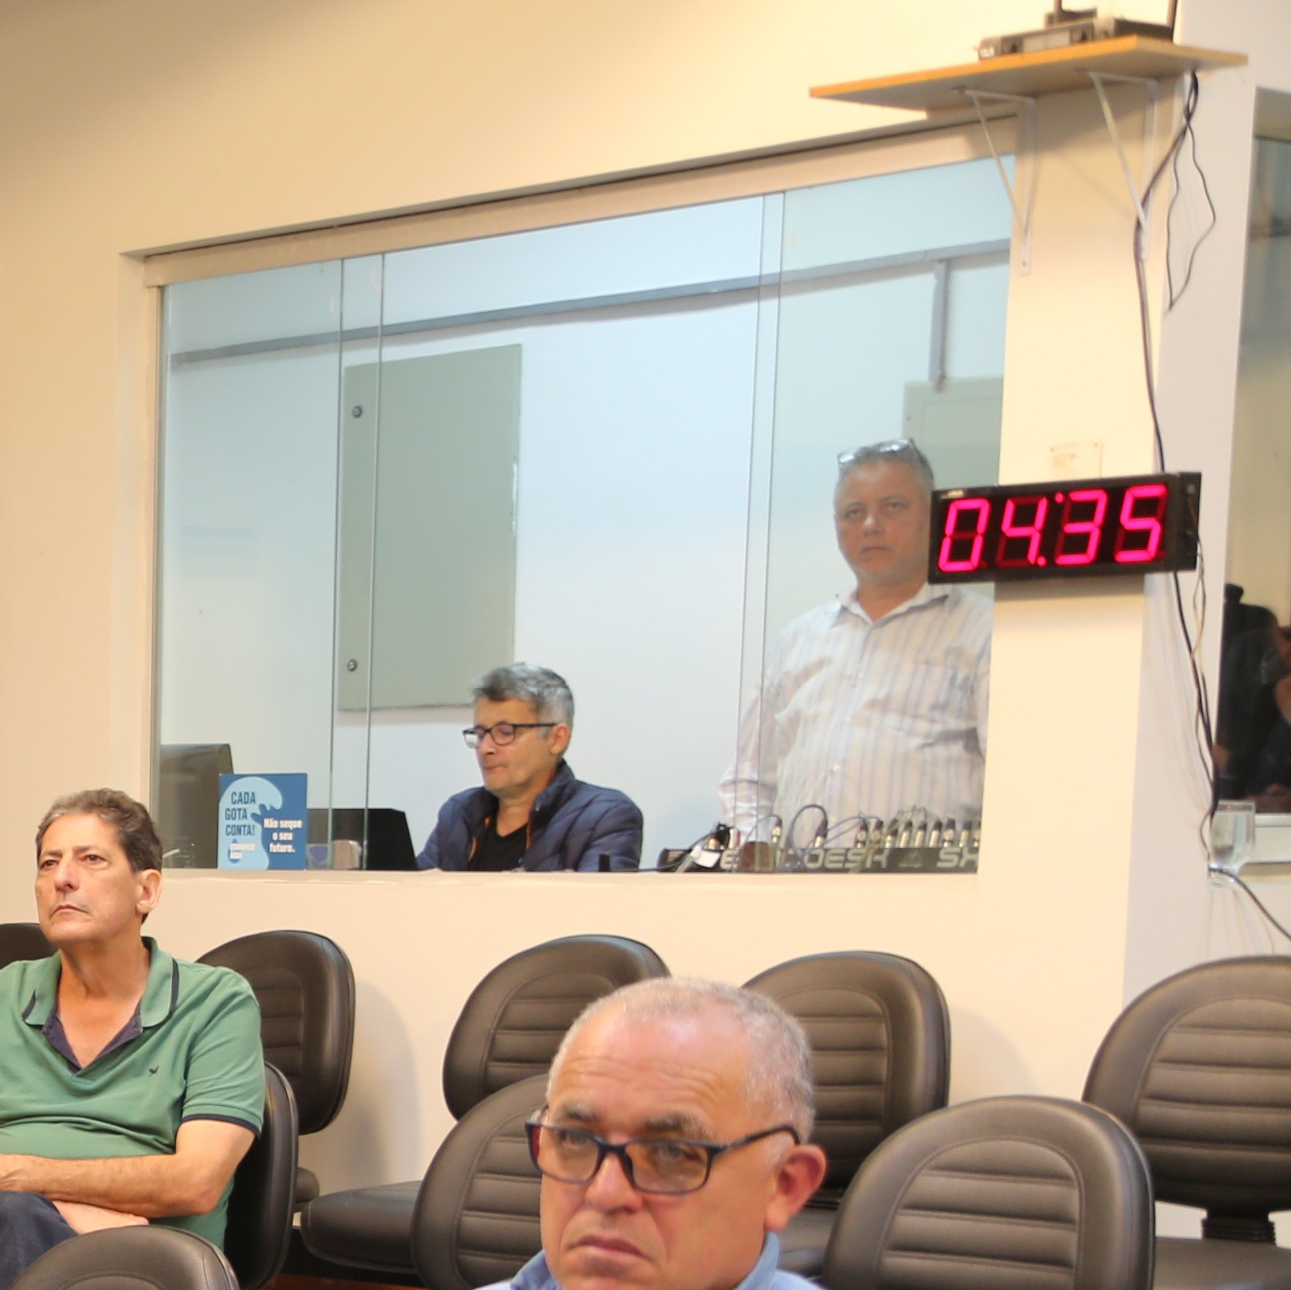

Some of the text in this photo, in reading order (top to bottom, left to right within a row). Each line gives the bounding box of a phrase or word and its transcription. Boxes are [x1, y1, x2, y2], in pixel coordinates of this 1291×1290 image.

[231, 792, 256, 804] CADA
[225, 808, 247, 820] GOTA
[226, 825, 255, 836] CONTA!
